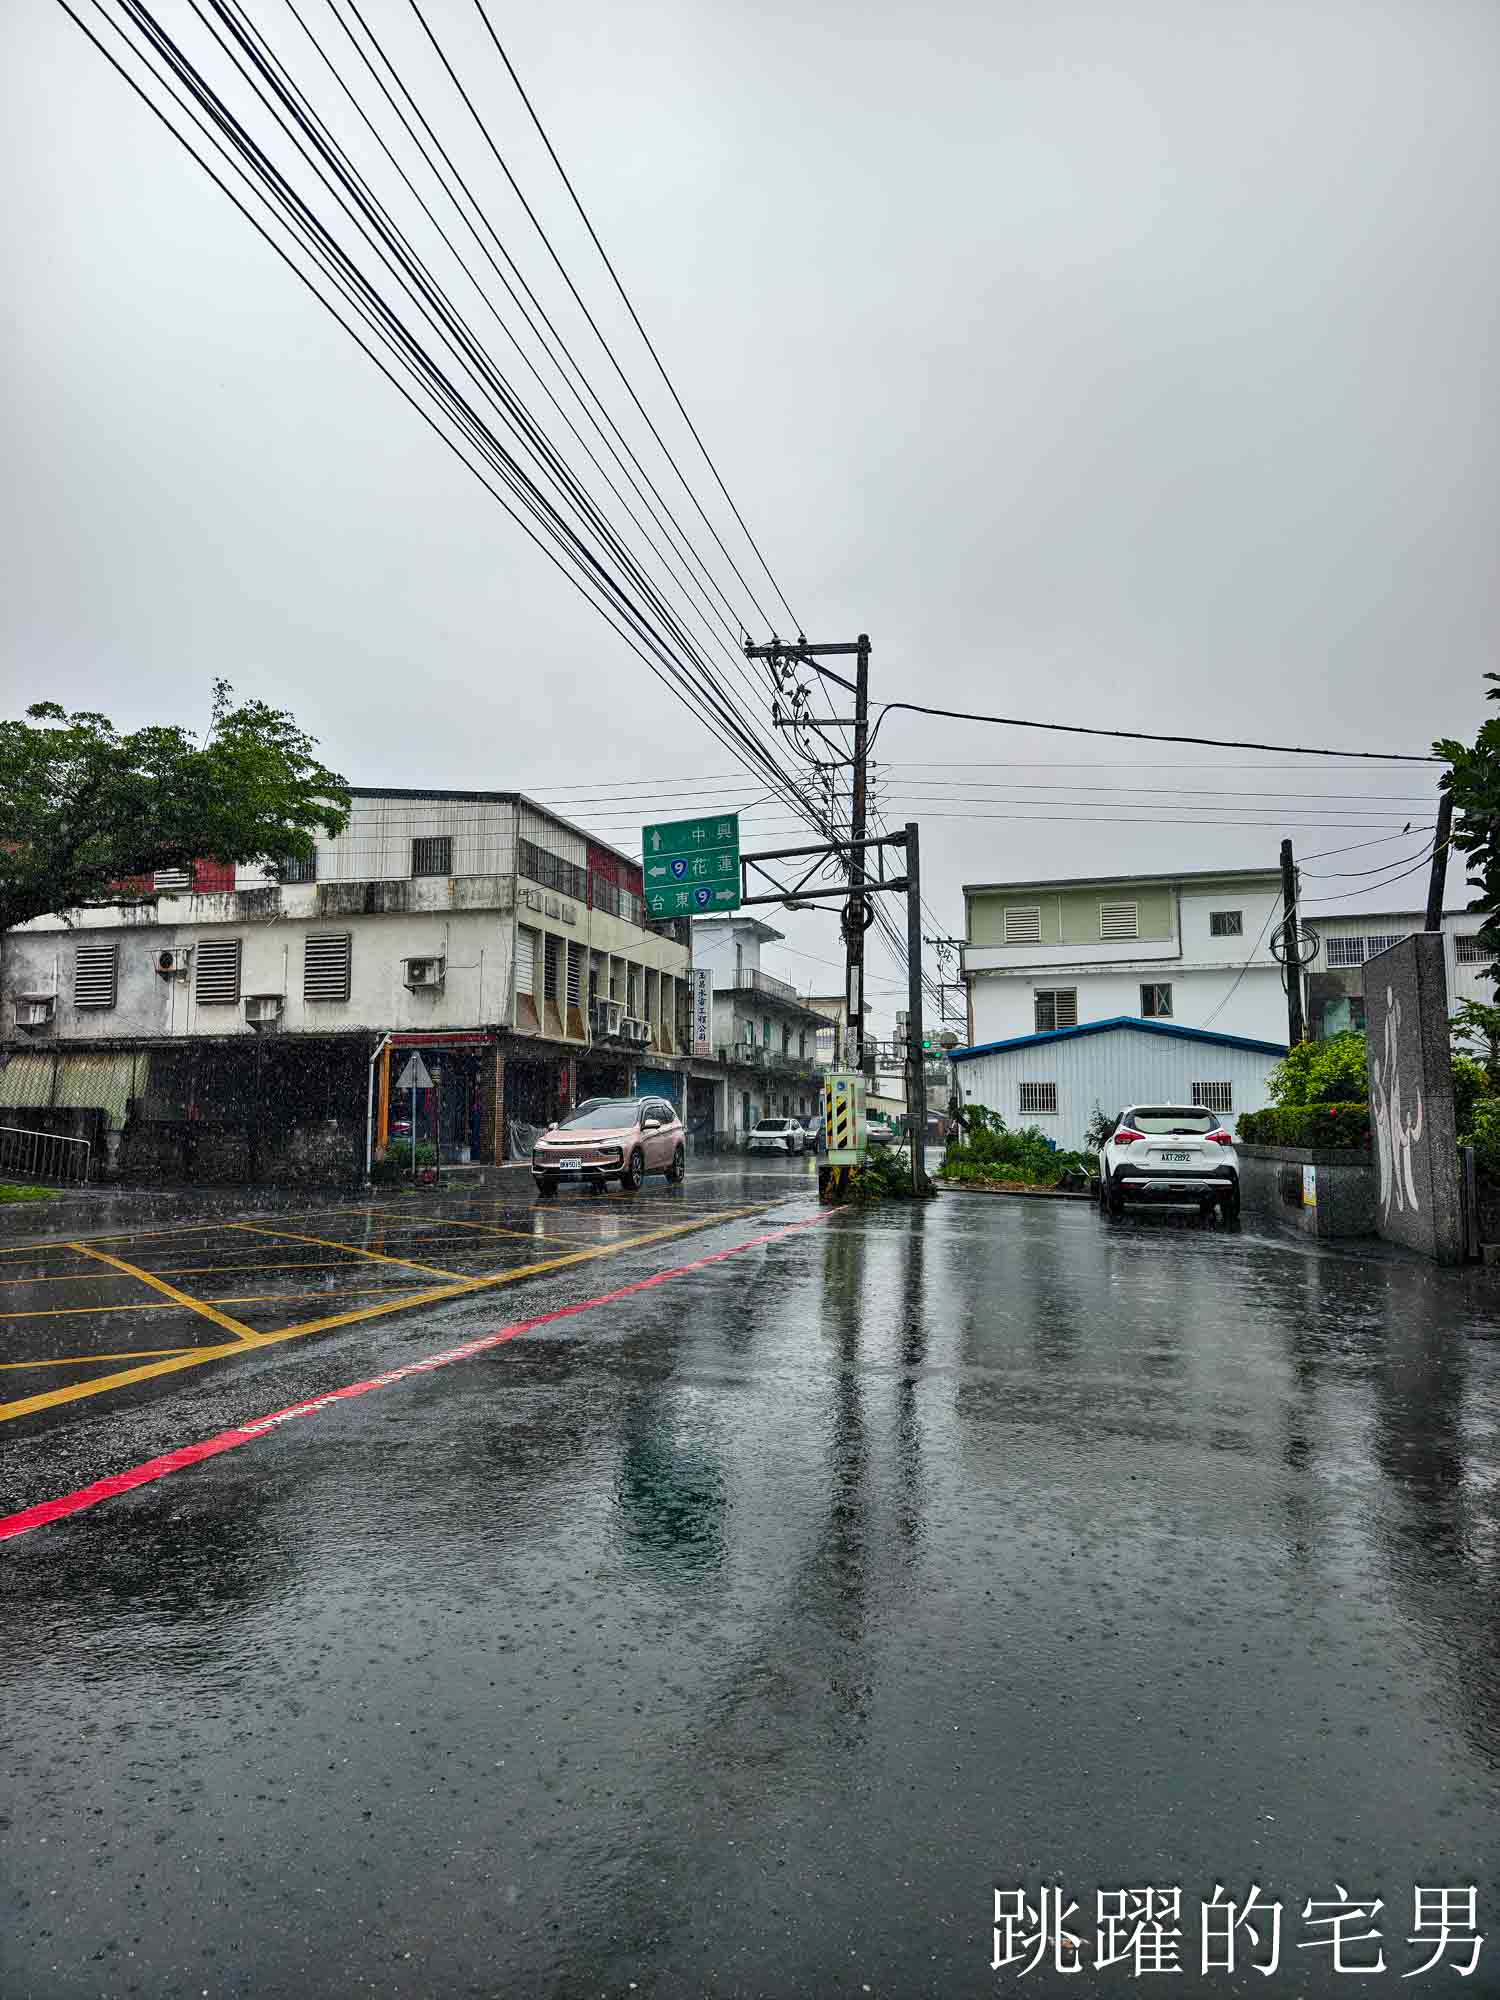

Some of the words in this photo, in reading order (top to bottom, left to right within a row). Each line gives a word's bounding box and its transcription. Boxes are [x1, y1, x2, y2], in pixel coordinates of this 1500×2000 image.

[692, 823, 732, 848] 中興
[674, 862, 684, 874] 9
[692, 854, 733, 876] 花蓮
[650, 892, 689, 911] 台東
[698, 890, 708, 902] 9
